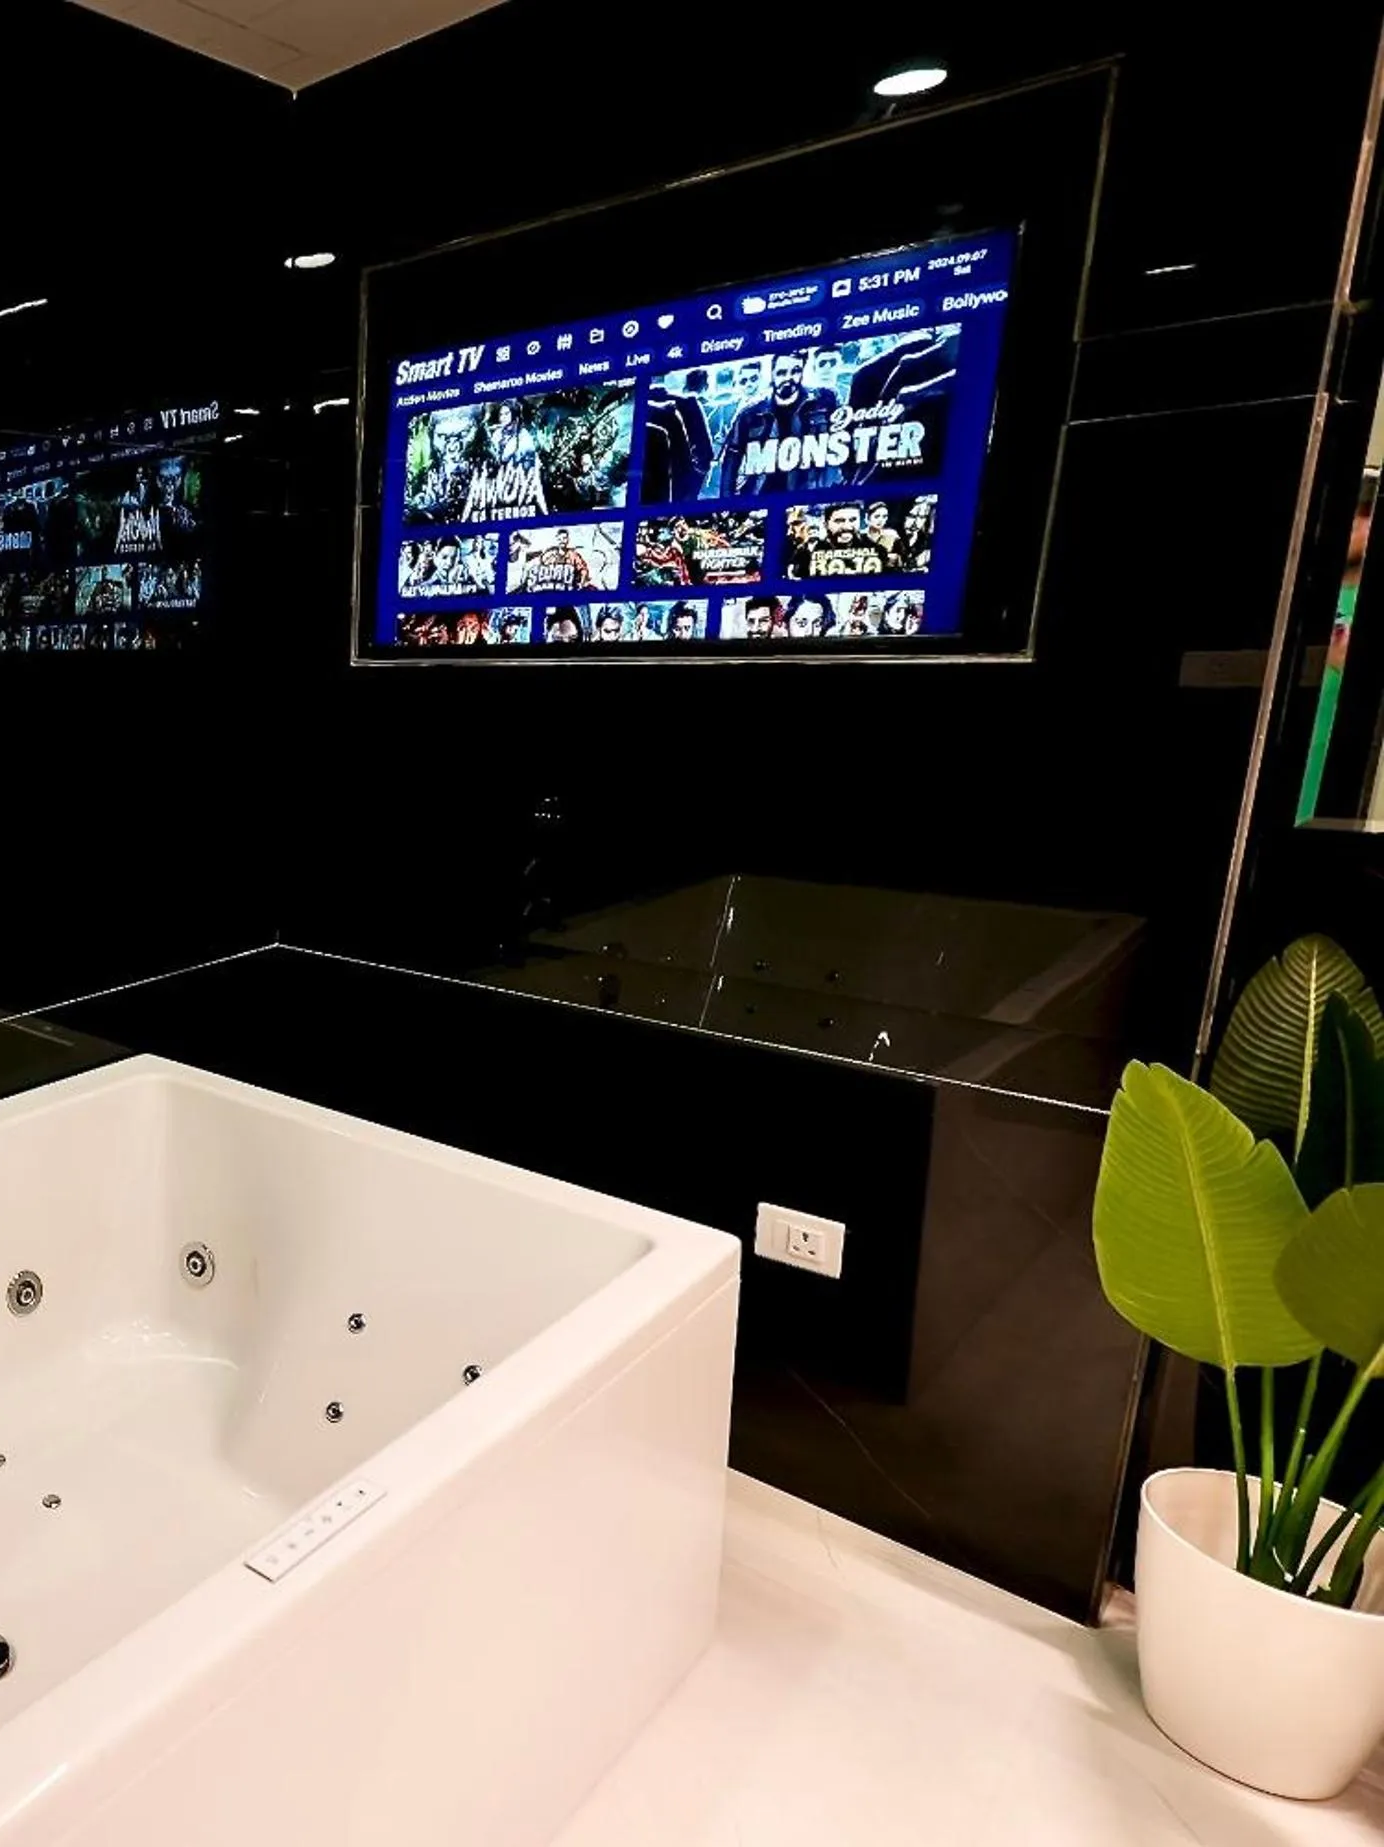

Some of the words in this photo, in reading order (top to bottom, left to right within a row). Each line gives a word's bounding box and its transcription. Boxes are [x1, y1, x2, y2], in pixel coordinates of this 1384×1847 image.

[858, 272, 889, 291] 5:31
[893, 267, 921, 285] PM
[942, 290, 1009, 312] Bollywo
[842, 314, 870, 330] Zee
[872, 303, 920, 324] Music
[764, 322, 822, 342] Trending
[701, 336, 744, 354] Disney
[395, 351, 454, 386] Smart
[457, 345, 486, 374] TV
[578, 360, 610, 375] News
[626, 353, 651, 367] Live
[525, 369, 564, 385] Movies
[829, 399, 906, 432] Daddy
[744, 421, 926, 475] MONSTER
[809, 556, 883, 577] RAJA
